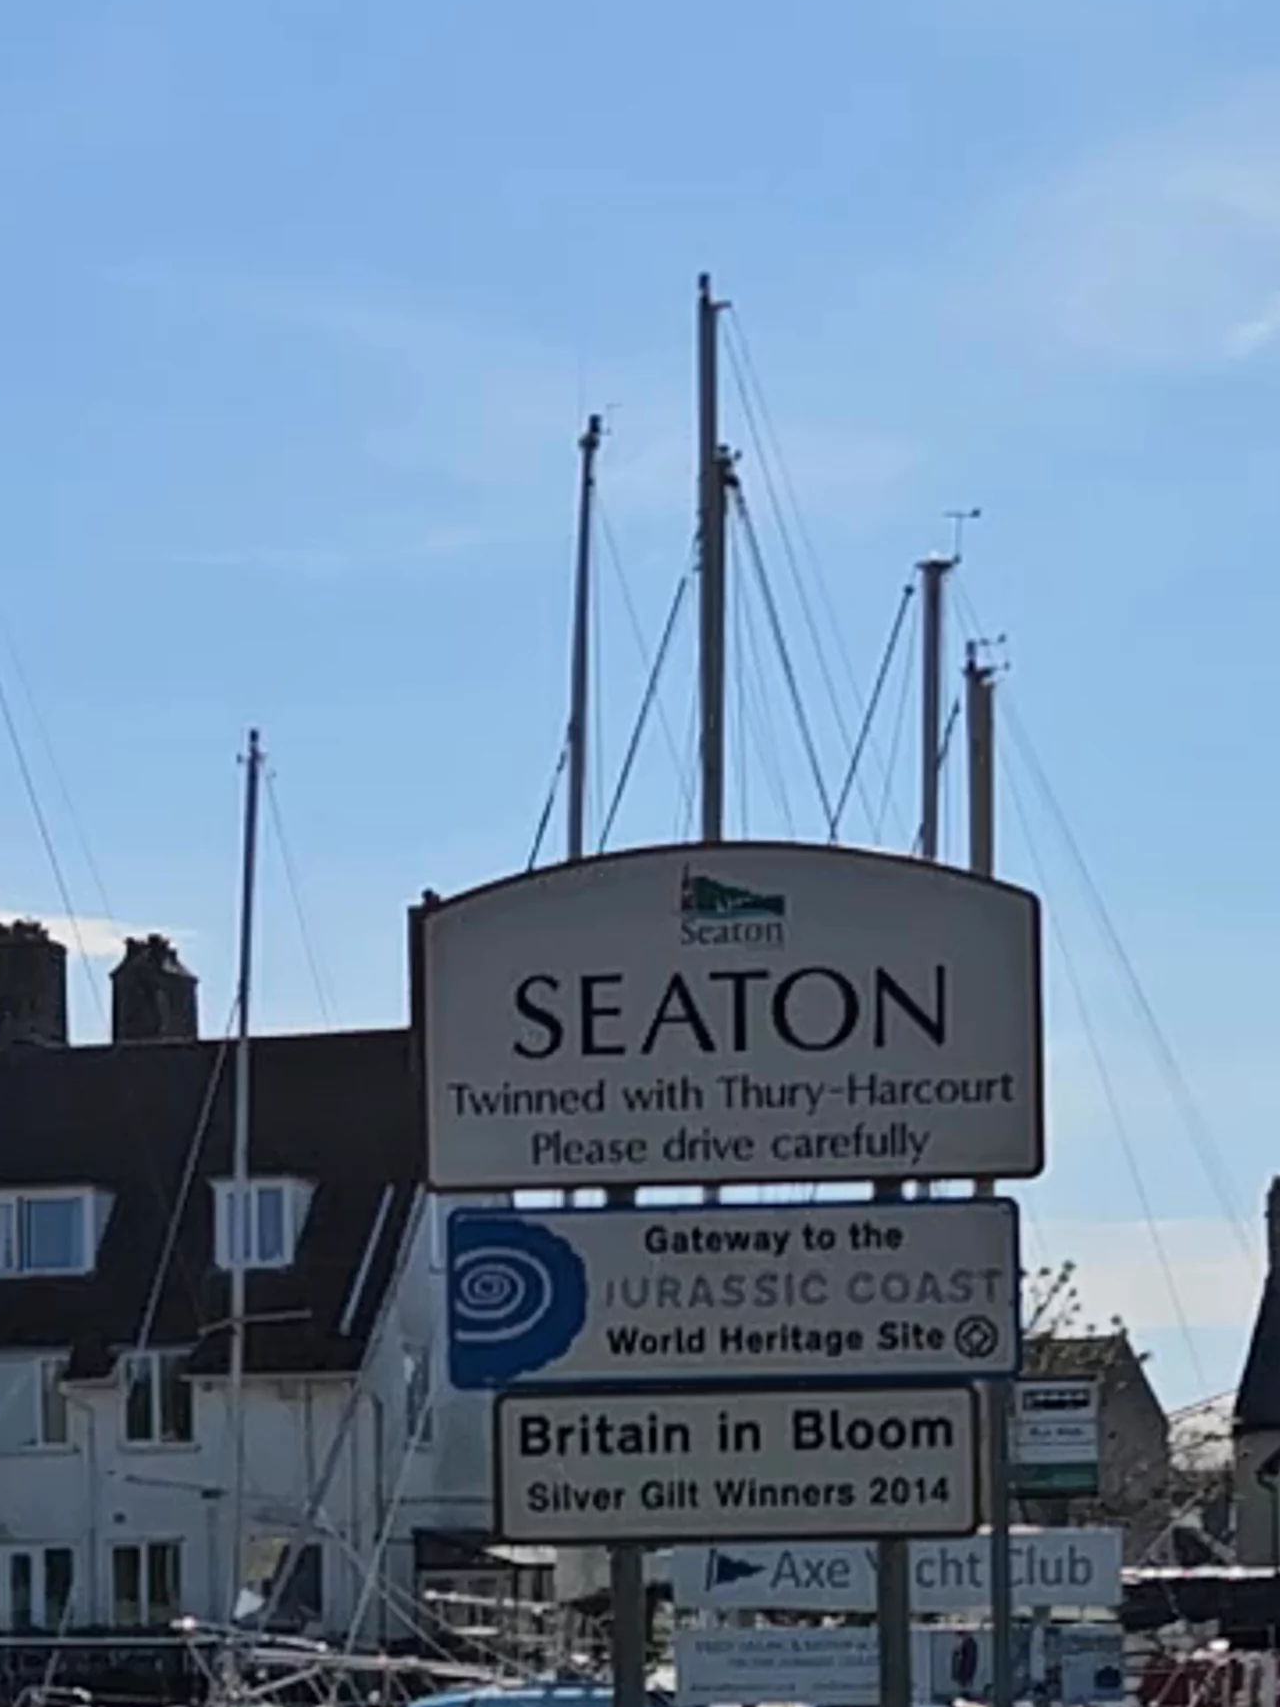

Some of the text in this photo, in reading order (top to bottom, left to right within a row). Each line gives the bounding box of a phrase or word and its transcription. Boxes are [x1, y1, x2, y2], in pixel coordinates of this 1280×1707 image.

[680, 914, 784, 946] Seaton
[513, 964, 947, 1061] SEATON
[448, 1072, 1015, 1117] Twinned with Thury-Harcourt
[532, 1121, 932, 1169] Please drive carefully
[644, 1220, 904, 1258] Gateway to the
[605, 1267, 1004, 1309] JURASSIC COAST
[607, 1320, 945, 1358] World Heritage Site
[519, 1409, 954, 1457] Britain in Bloom
[528, 1476, 950, 1514] Silver Gilt Winners 2014
[769, 1550, 851, 1590] Axe
